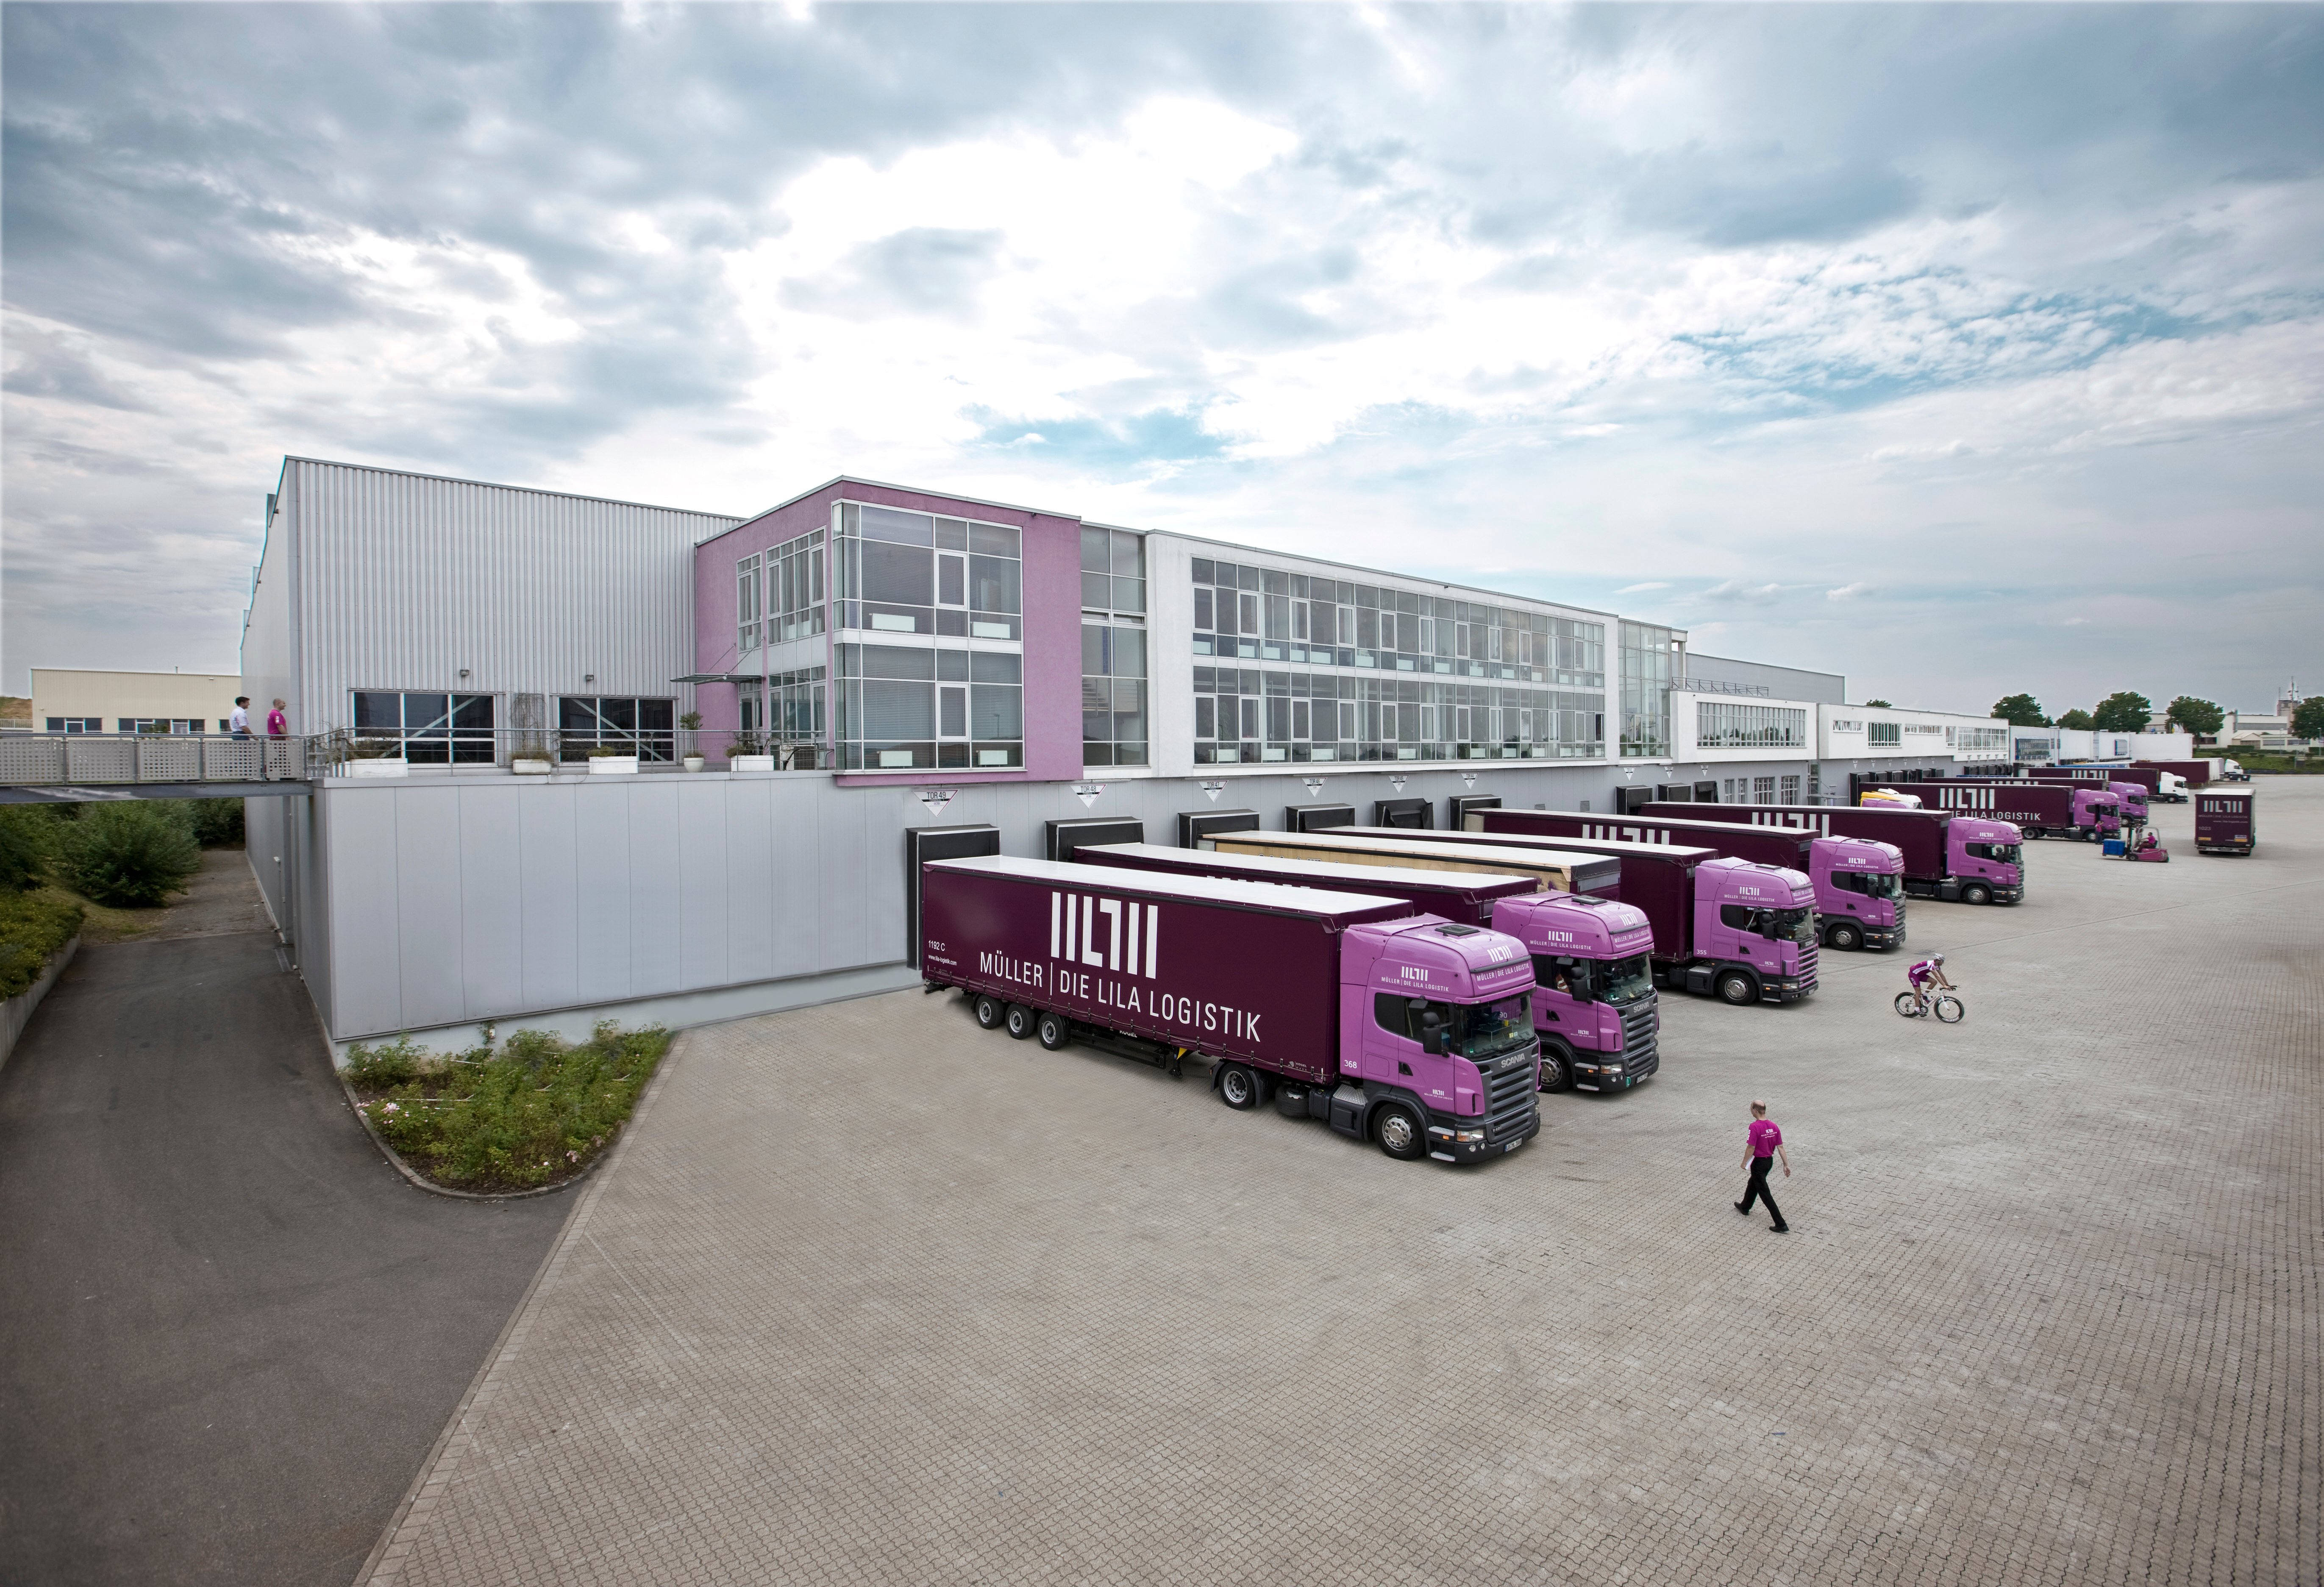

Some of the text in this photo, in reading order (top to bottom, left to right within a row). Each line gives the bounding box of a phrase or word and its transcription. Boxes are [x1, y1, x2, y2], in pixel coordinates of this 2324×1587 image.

[1992, 811, 2041, 821] LOGISTIK
[928, 940, 945, 951] 1192 C
[928, 955, 957, 966] www.lila-logistik.com
[1476, 972, 1495, 982] MÜLLER
[1514, 963, 1529, 972] LOGISTIK
[1425, 984, 1449, 992] LOGISTIK
[981, 949, 1261, 1042] MÜLLER DIE LILA LOGISTIK
[1633, 1002, 1649, 1013] SCANIA
[1344, 1060, 1357, 1069] 368
[1501, 1053, 1525, 1068] SCANIA
